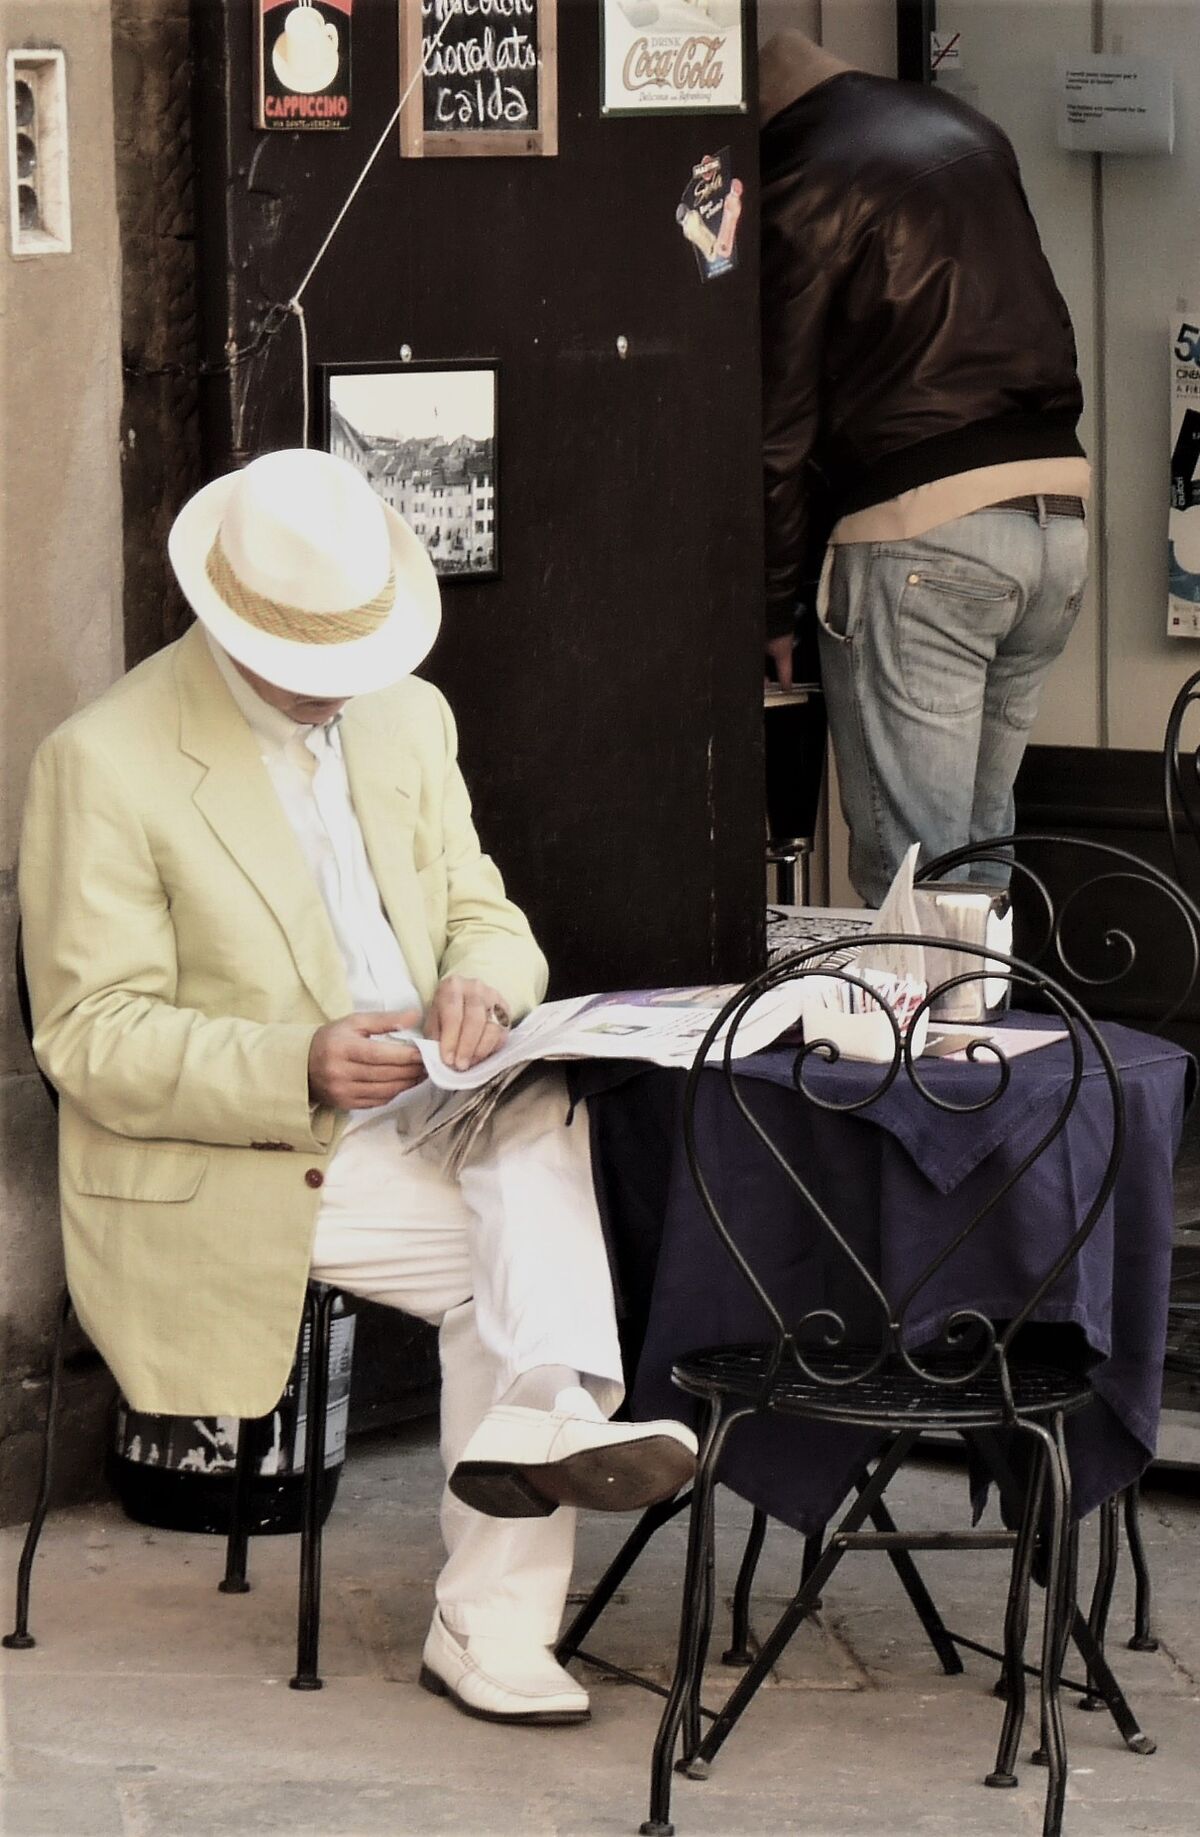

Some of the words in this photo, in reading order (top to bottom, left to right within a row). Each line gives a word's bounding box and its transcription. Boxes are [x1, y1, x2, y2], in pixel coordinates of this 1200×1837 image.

[651, 37, 681, 48] DRINK
[622, 36, 727, 91] Coca-Cola
[265, 95, 348, 117] CAPPUCCINO
[435, 77, 529, 122] calda
